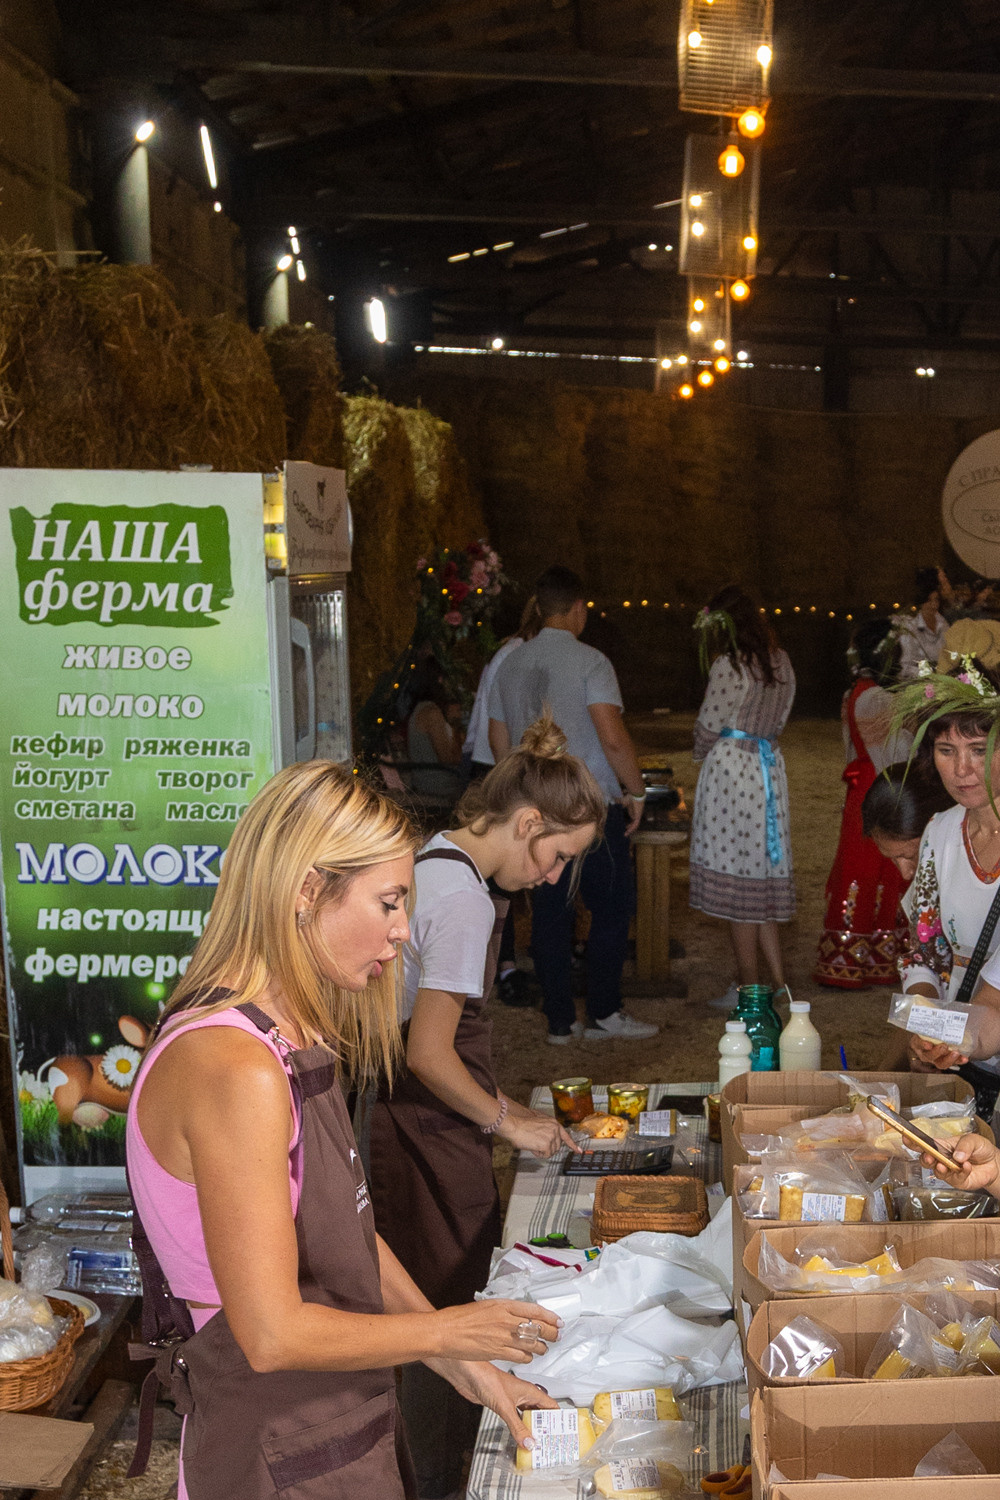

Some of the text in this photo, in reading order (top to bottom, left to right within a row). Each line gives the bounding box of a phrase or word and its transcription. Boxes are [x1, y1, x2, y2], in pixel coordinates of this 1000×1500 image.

[27, 519, 203, 564] НАША
[23, 568, 214, 622] ферма
[61, 644, 192, 671] живое
[57, 692, 205, 719] молоко
[11, 732, 252, 761] кефир ряженка
[12, 761, 255, 795] йогурт творог
[14, 799, 135, 821] сметана
[15, 842, 228, 887] МОЛОК
[37, 907, 211, 938] настоящ
